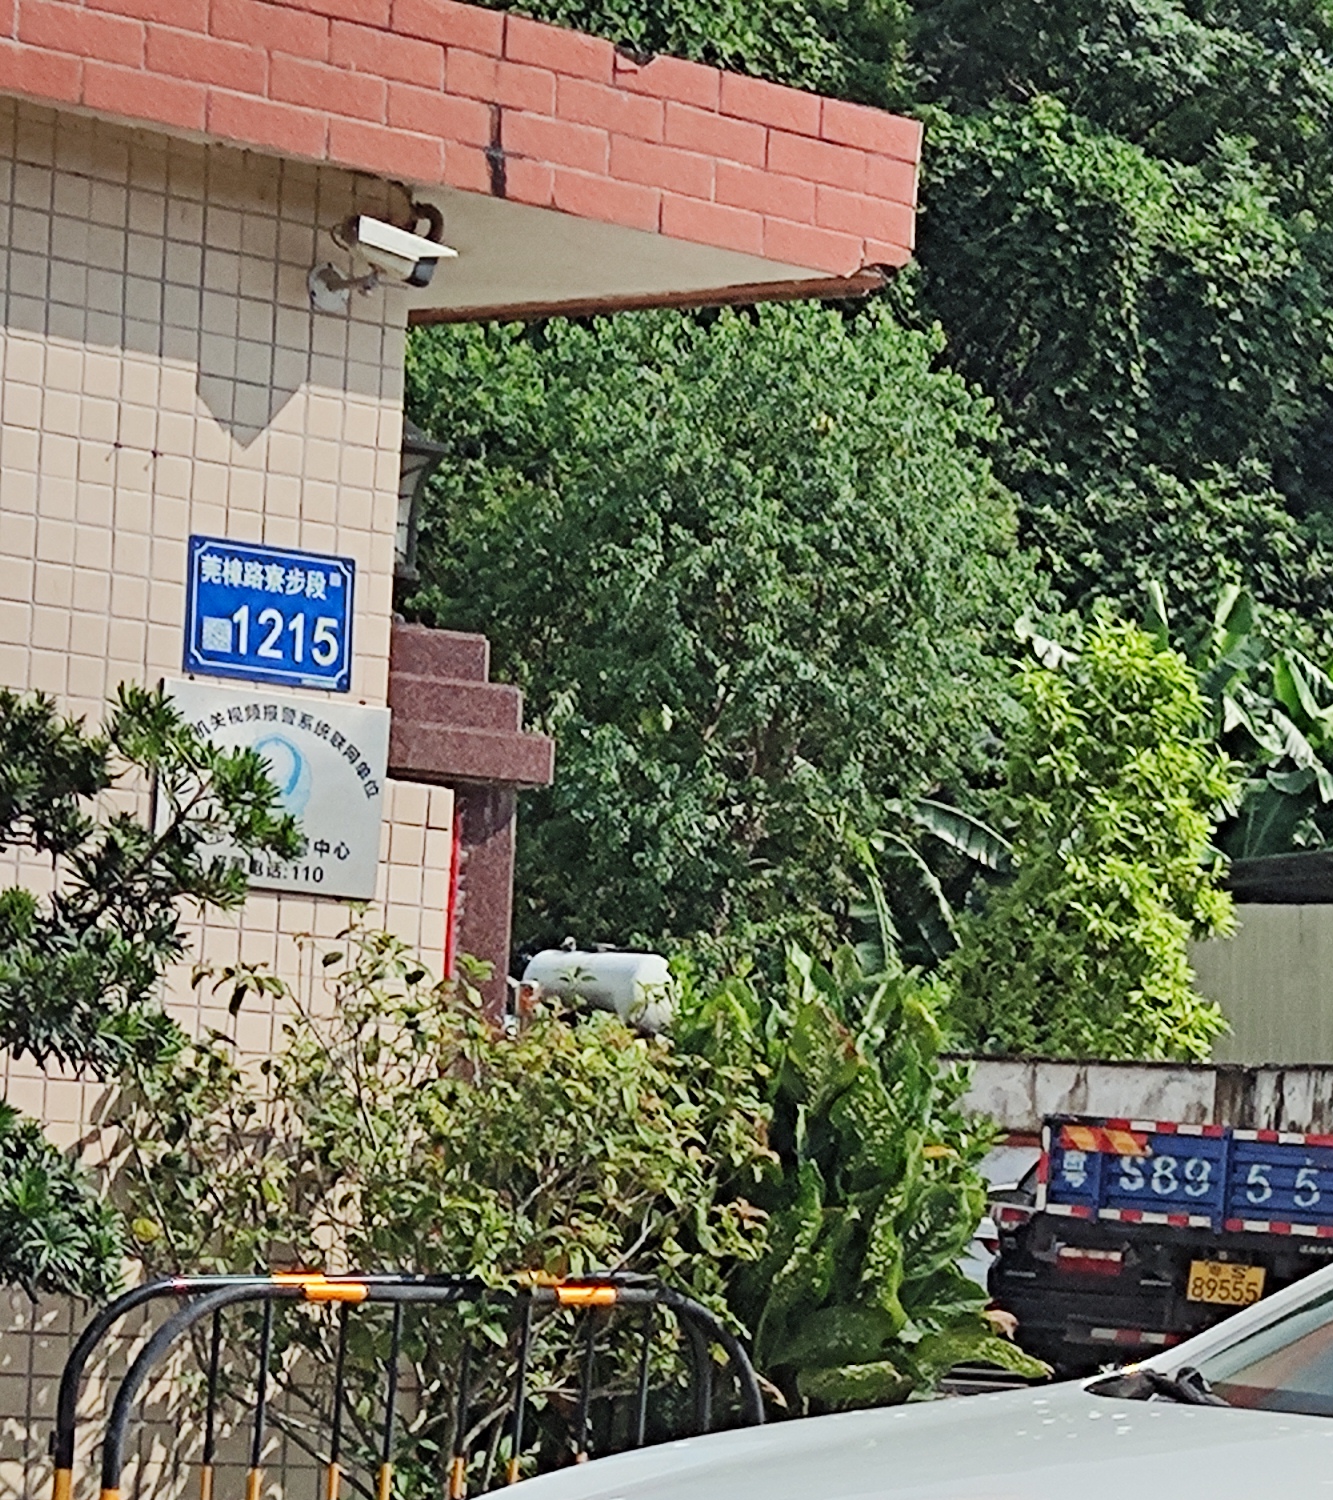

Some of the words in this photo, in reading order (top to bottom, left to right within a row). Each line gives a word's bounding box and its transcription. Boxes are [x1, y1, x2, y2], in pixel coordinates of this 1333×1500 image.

[200, 553, 327, 600] 莞樟路寮步段
[232, 604, 339, 667] 1215
[1191, 1276, 1259, 1302] 89555
